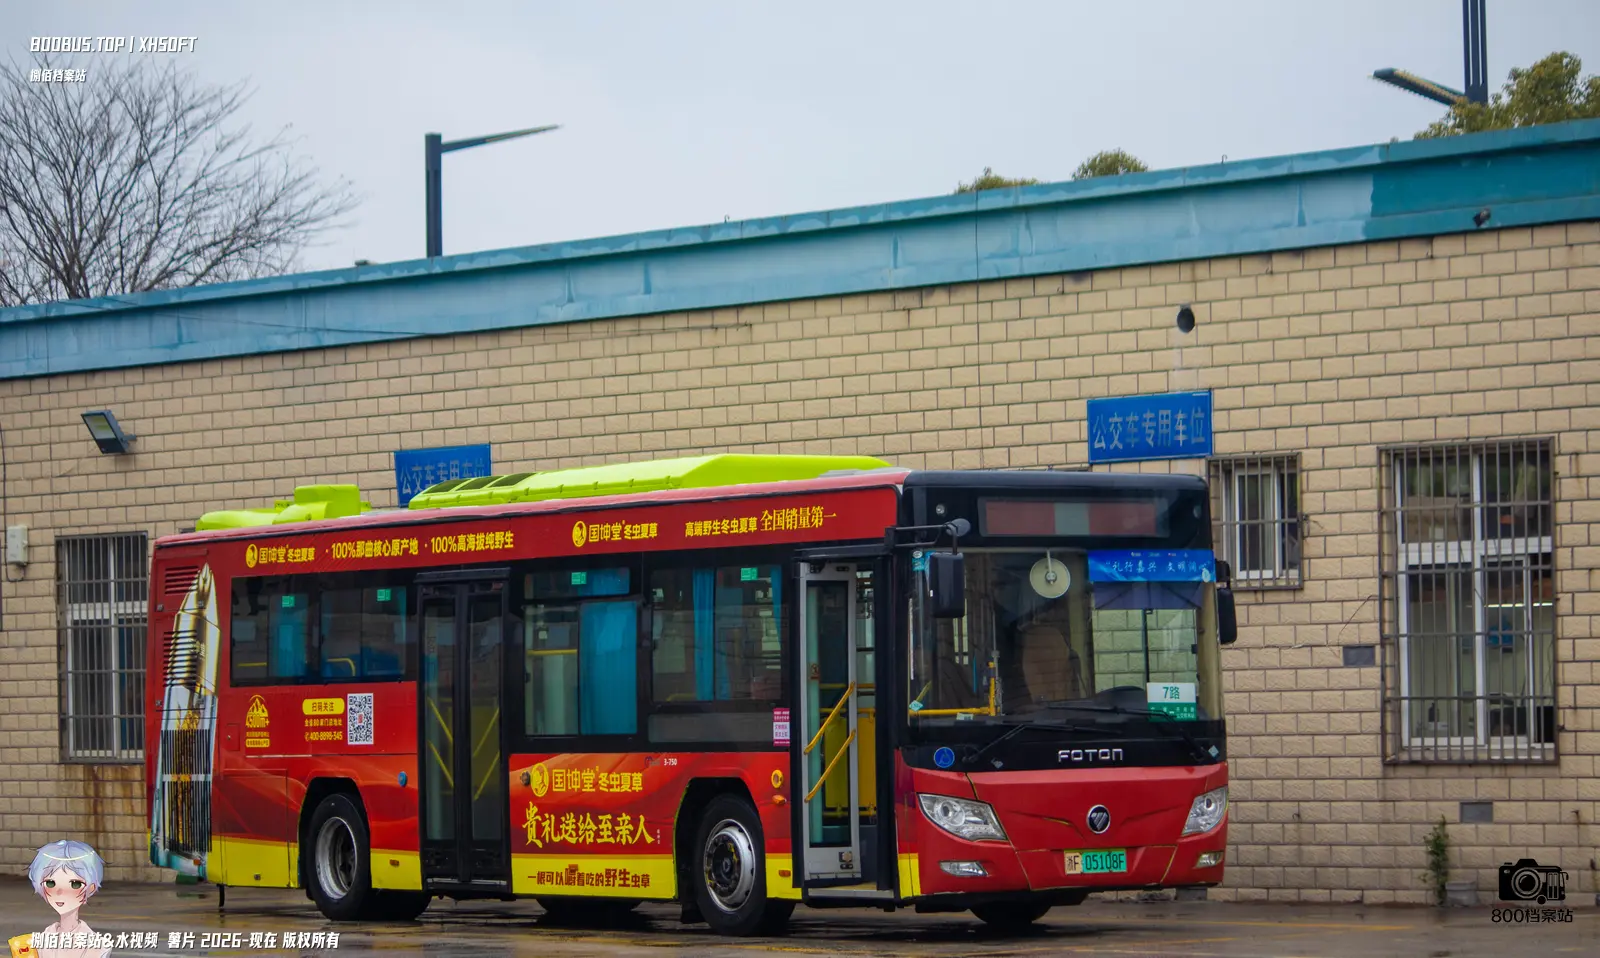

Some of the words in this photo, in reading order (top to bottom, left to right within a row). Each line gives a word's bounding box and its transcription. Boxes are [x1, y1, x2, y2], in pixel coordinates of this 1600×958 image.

[1093, 406, 1206, 449] 公交车专用车位
[685, 516, 758, 538] 高端野生冬虫夏草
[760, 505, 837, 531] 全国销量第一
[1162, 686, 1180, 700] 7路
[312, 701, 334, 712] 扫码关注
[663, 758, 677, 766] 3-750
[1058, 748, 1123, 762] FOTON
